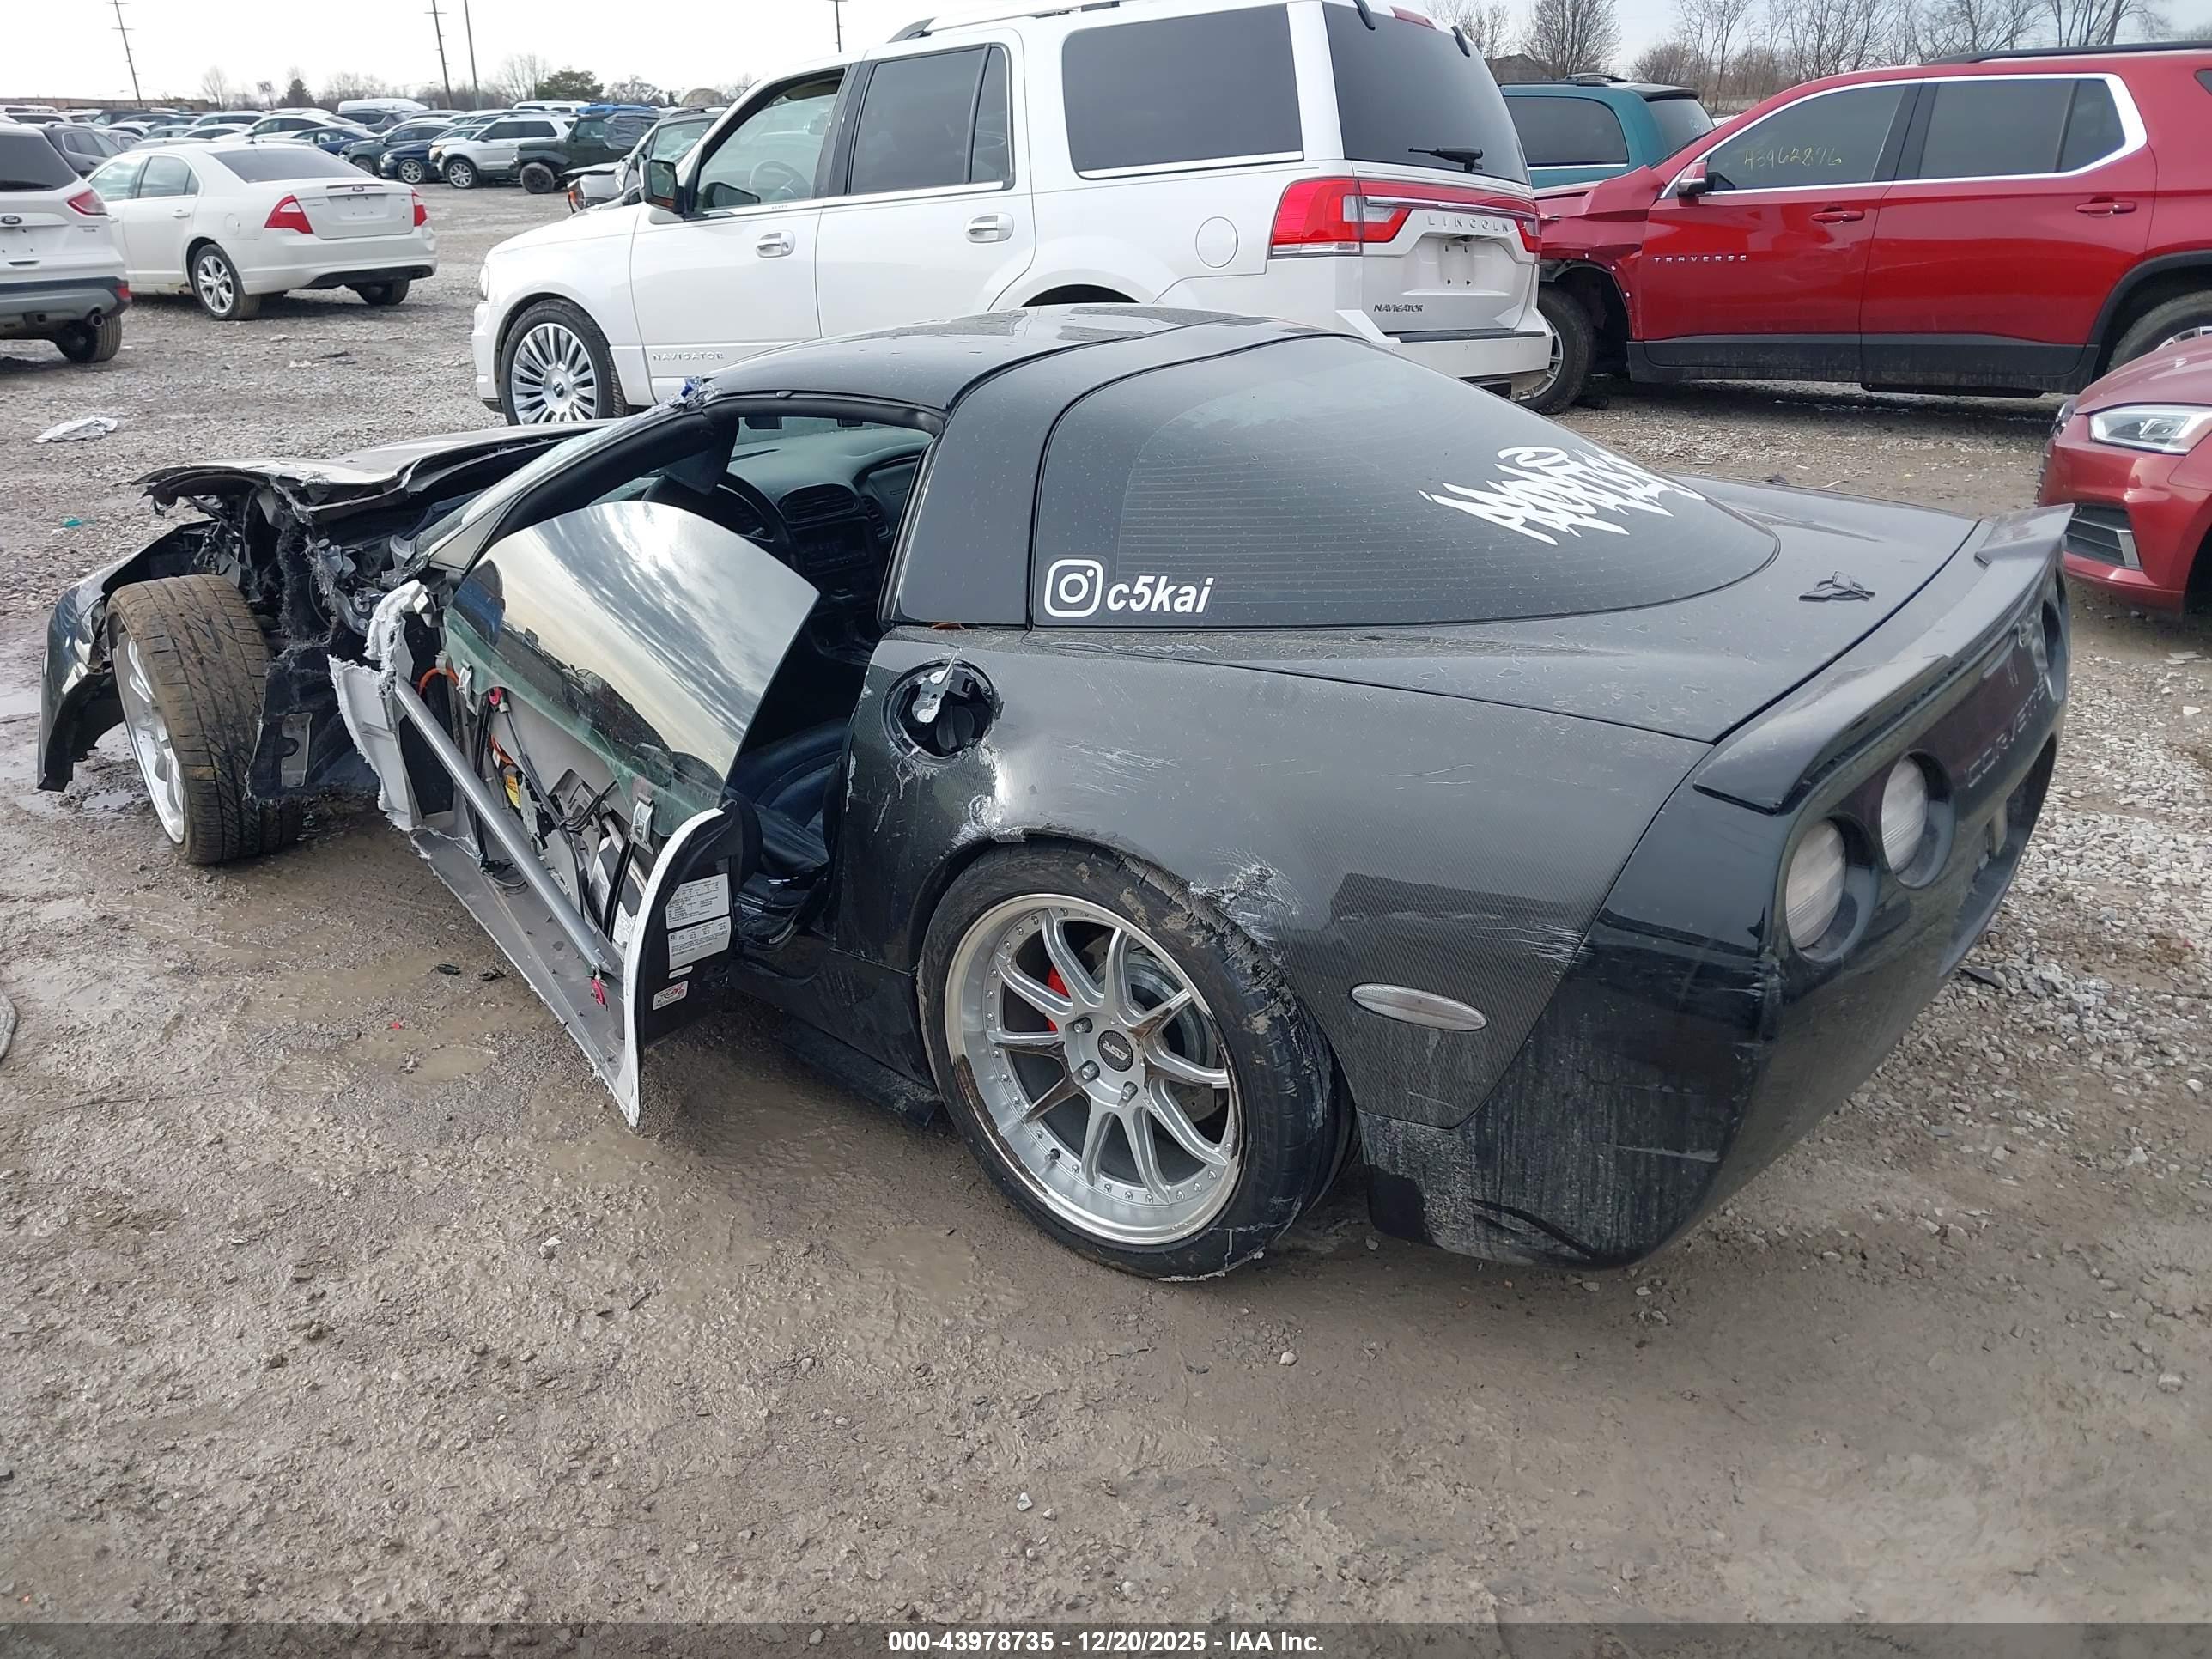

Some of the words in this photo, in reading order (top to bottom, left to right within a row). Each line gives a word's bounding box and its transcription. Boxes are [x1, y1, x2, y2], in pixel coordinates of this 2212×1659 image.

[1427, 214, 1509, 232] LINCOLN
[1374, 303, 1424, 313] NAVIGATOR
[653, 350, 724, 362] NAVIGATOR
[1107, 575, 1214, 613] c5kai
